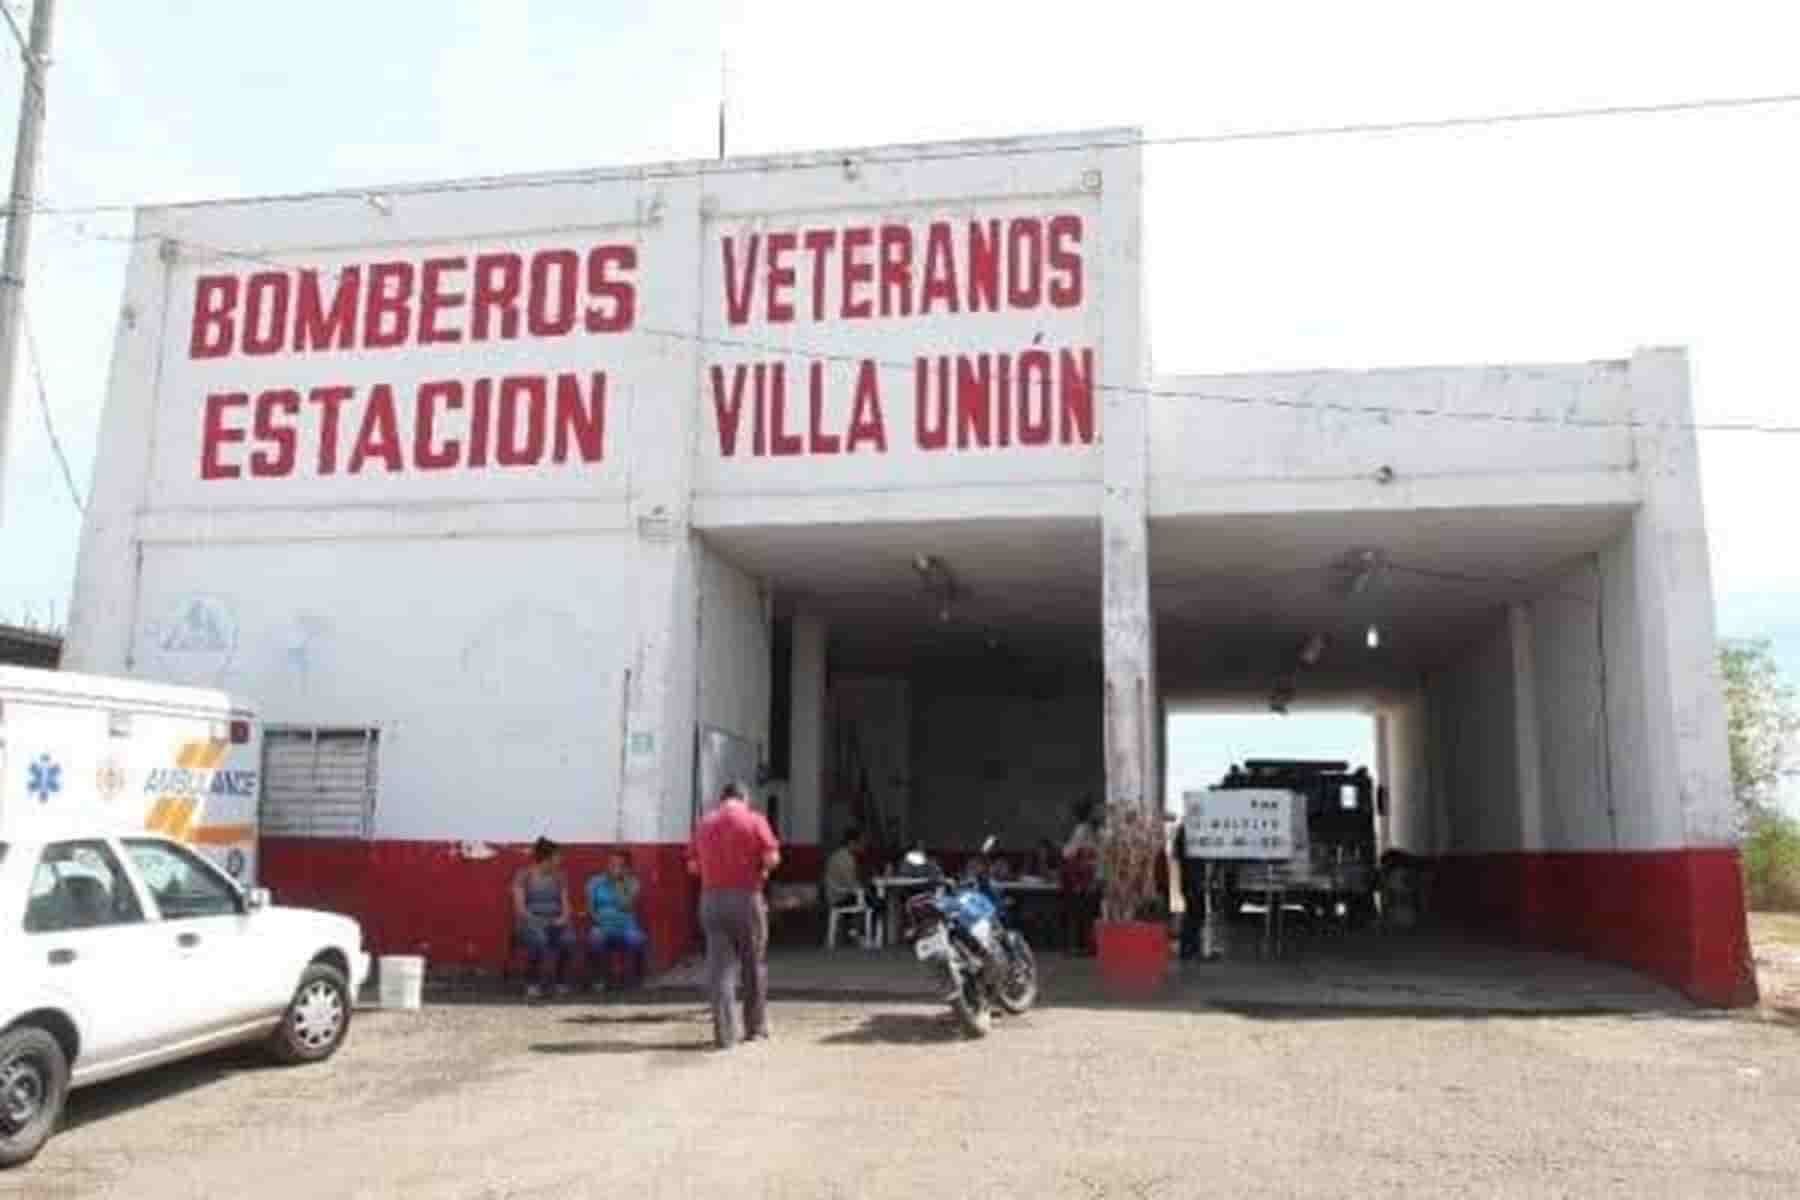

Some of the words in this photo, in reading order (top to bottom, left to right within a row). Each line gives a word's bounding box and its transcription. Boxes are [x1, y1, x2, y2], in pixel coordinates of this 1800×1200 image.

[189, 244, 637, 358] BOMBEROS
[722, 215, 1084, 324] VETERANOS
[200, 371, 607, 480] ESTACION
[711, 359, 888, 457] VILLA
